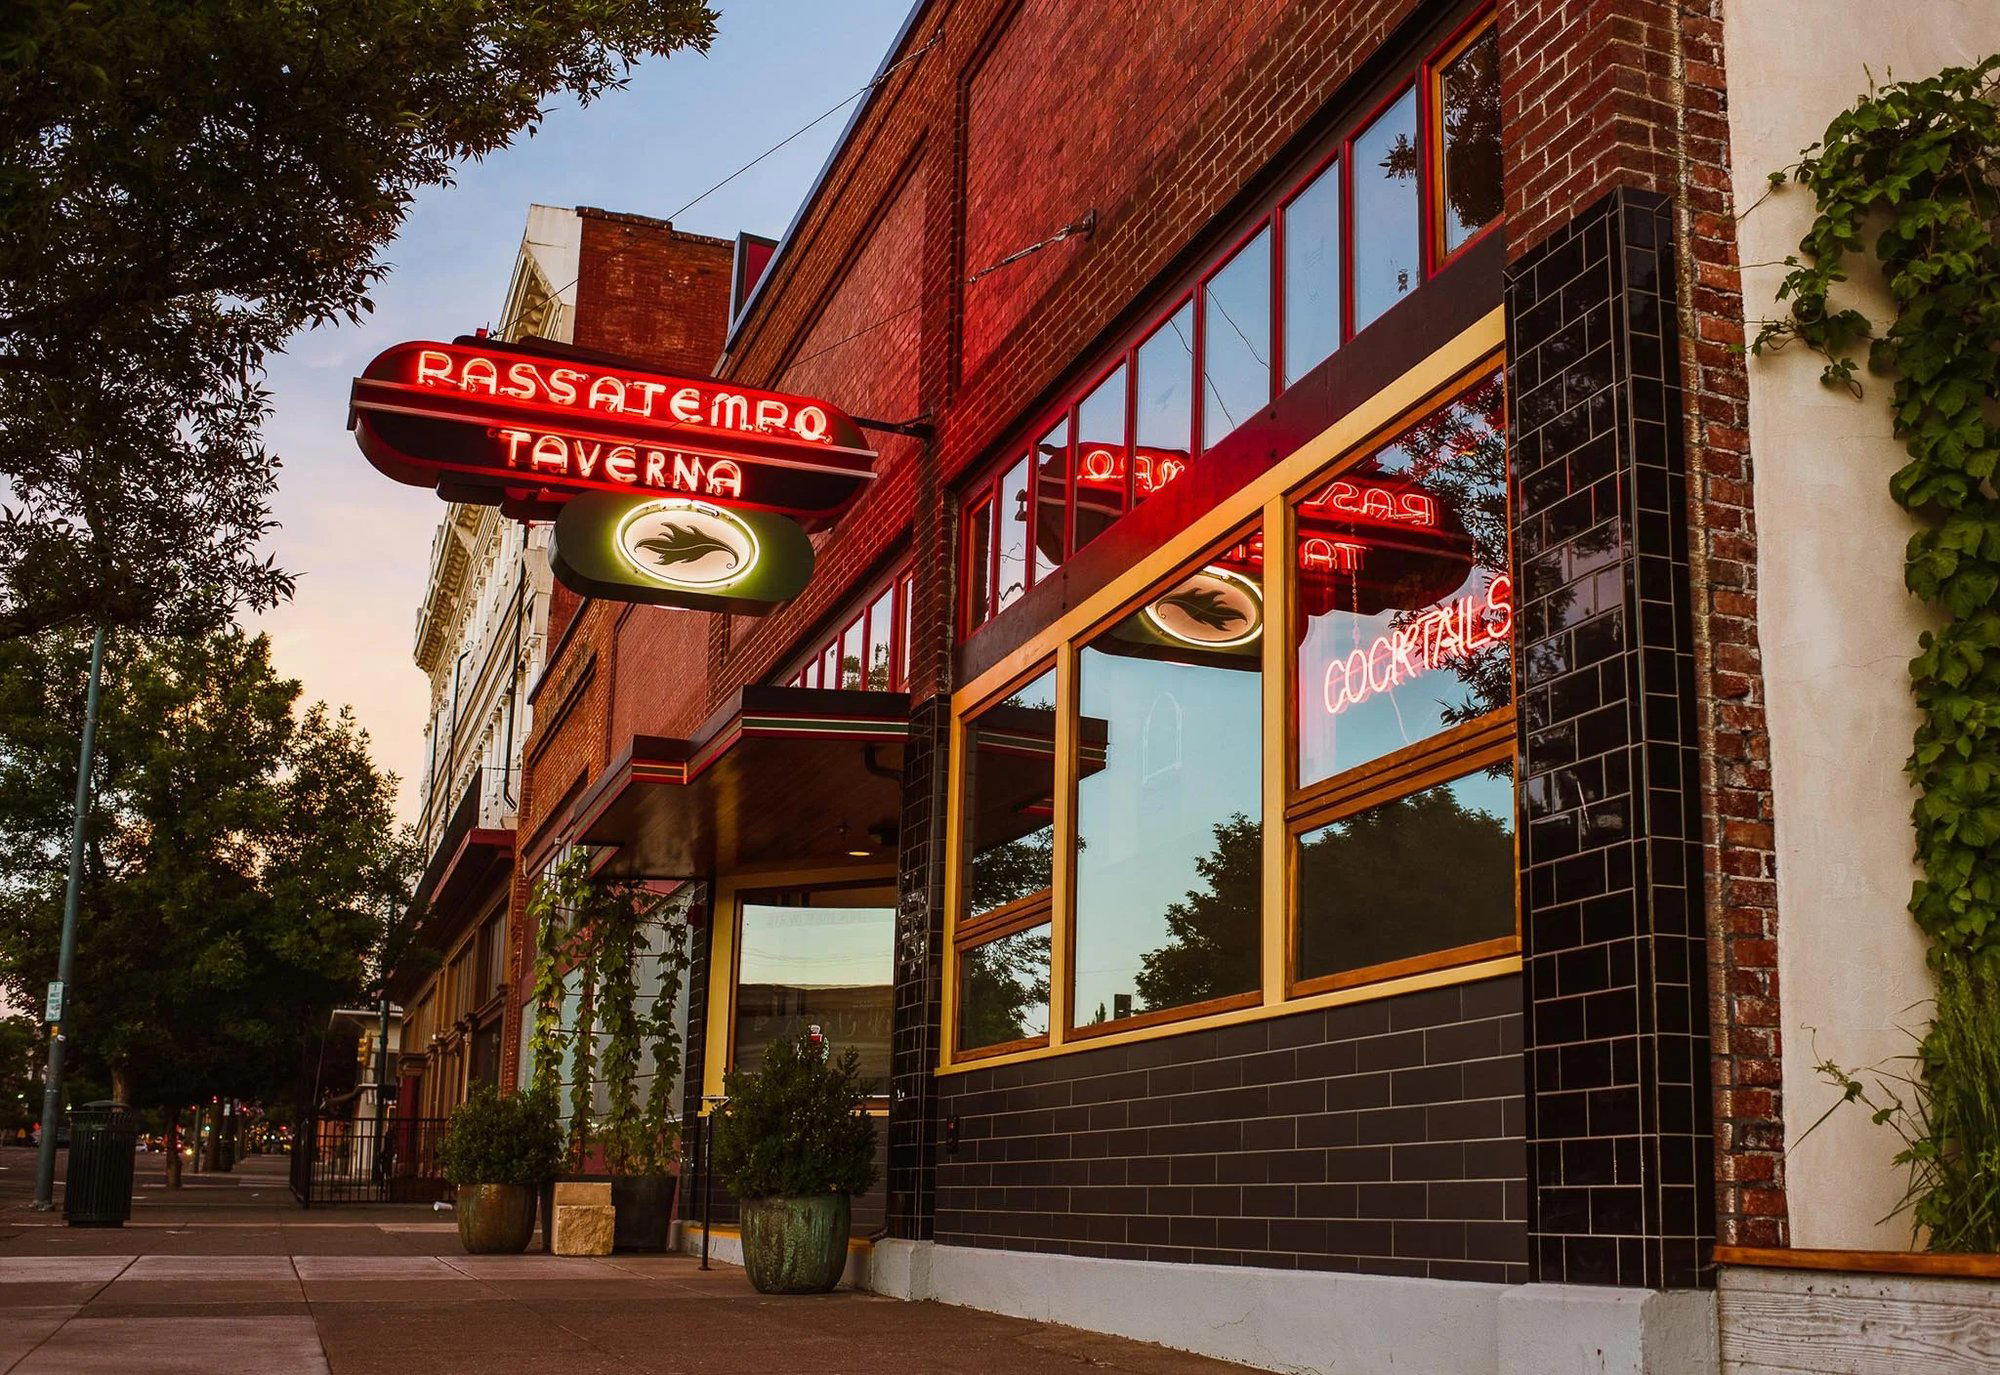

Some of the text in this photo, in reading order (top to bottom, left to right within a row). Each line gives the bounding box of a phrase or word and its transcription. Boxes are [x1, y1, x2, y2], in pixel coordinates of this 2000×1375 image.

[418, 351, 827, 441] PASSATEMPO
[501, 429, 742, 497] TAVERNA
[1324, 575, 1512, 714] COCKTAILS
